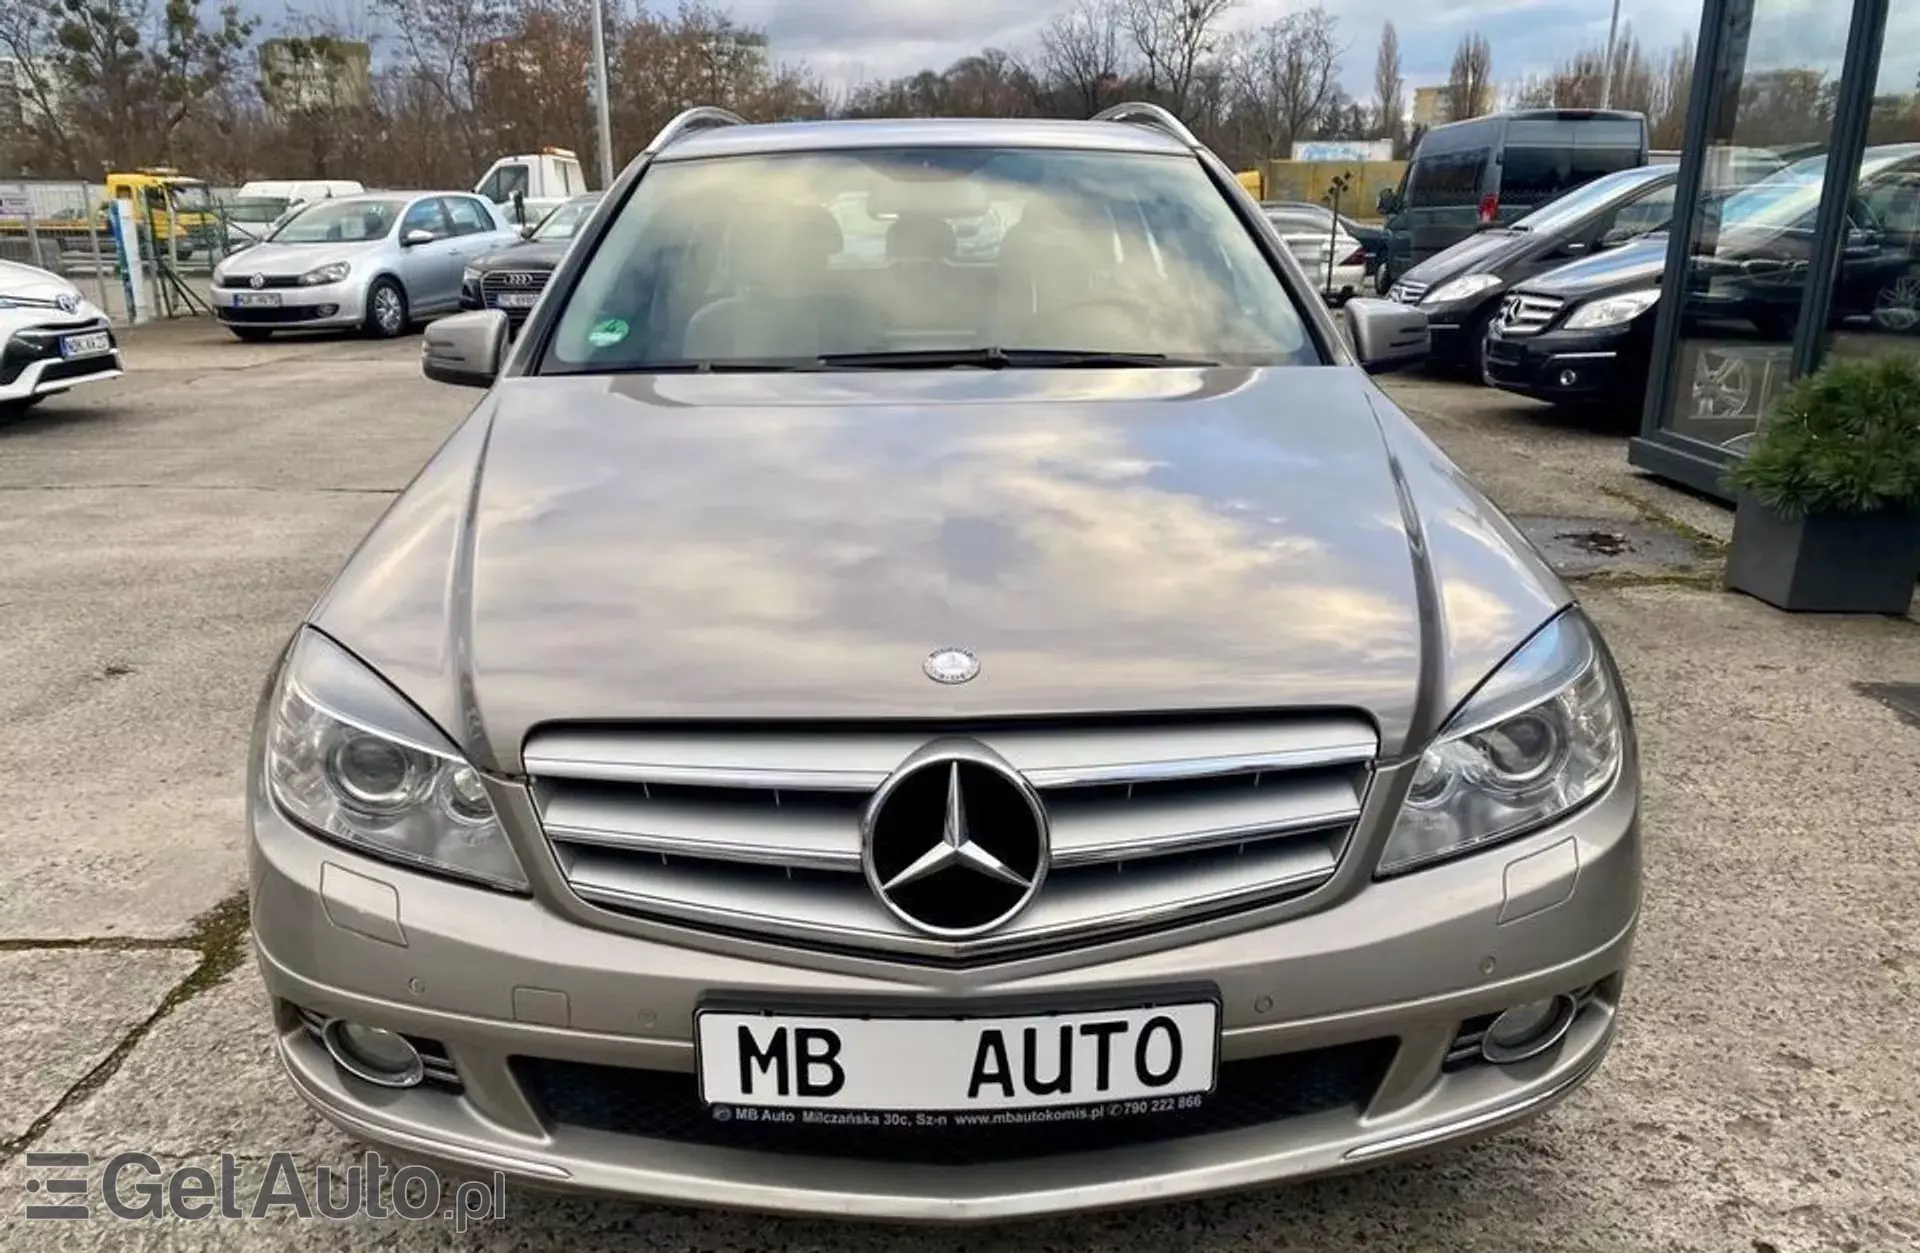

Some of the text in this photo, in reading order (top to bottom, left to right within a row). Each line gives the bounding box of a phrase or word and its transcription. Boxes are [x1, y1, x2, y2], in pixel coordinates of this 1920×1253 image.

[738, 1016, 1183, 1098] MB AUTO
[735, 1108, 758, 1121] MB
[761, 1109, 795, 1122] Auto
[802, 1110, 880, 1126] Milczańska
[954, 1106, 1105, 1125] www.mbautokomis.pl
[1124, 1102, 1148, 1115] 790
[1152, 1098, 1175, 1112] 222
